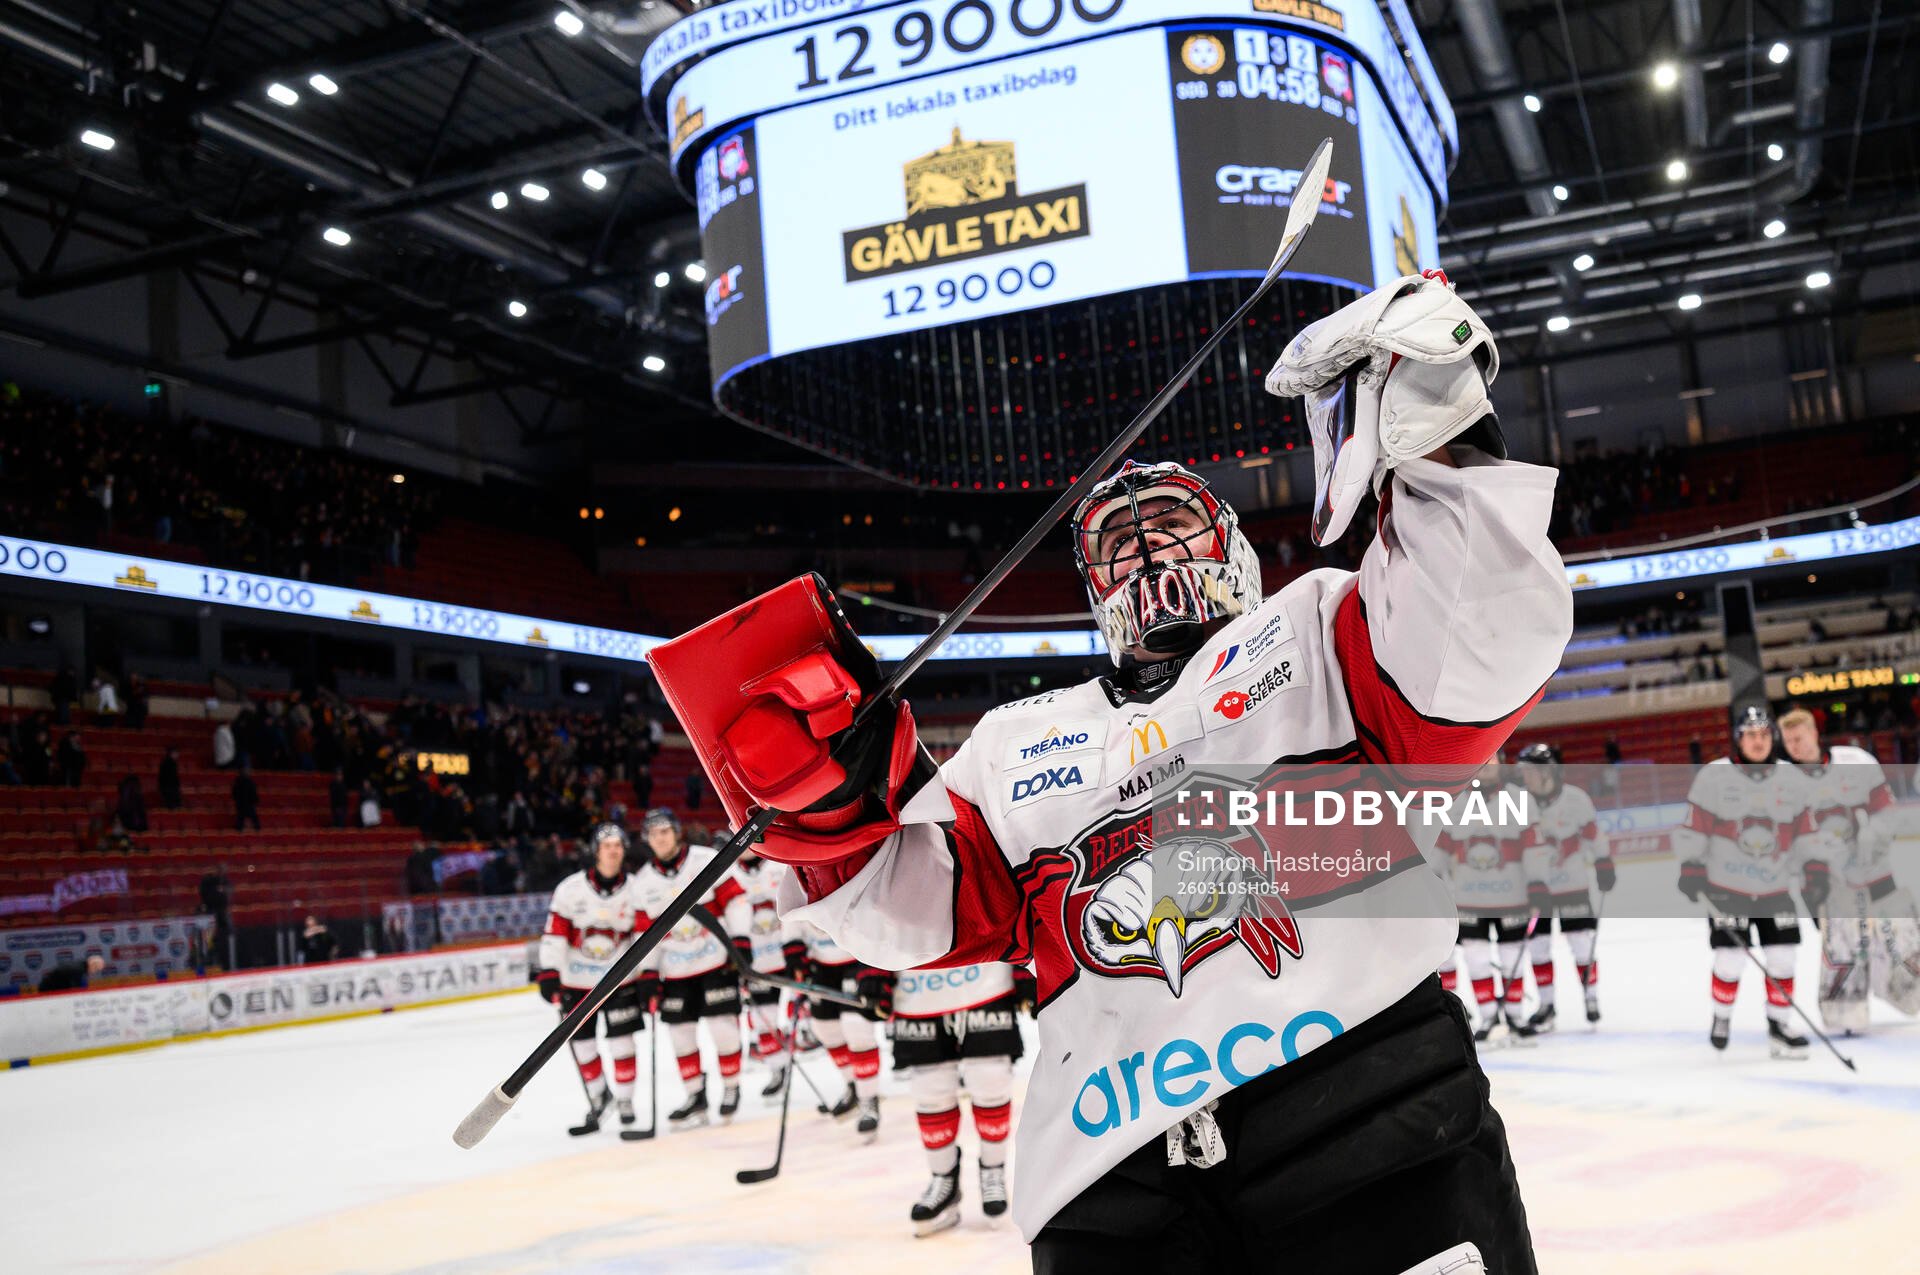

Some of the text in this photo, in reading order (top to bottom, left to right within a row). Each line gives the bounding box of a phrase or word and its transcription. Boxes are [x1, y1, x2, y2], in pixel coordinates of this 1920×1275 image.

[834, 64, 1077, 131] Ditt lokala taxibolag
[850, 195, 1081, 273] GÄVLE TAXI
[1246, 615, 1281, 649] Climat80
[1248, 625, 1281, 656] Gruppen
[1245, 671, 1293, 711] ENERGY
[1249, 661, 1291, 697] CHEAP
[1020, 733, 1089, 759] TREANO
[1012, 765, 1084, 802] DOXA
[1118, 753, 1186, 802] MALMÖ
[244, 962, 499, 1013] EN BRA START
[901, 965, 981, 994] areco
